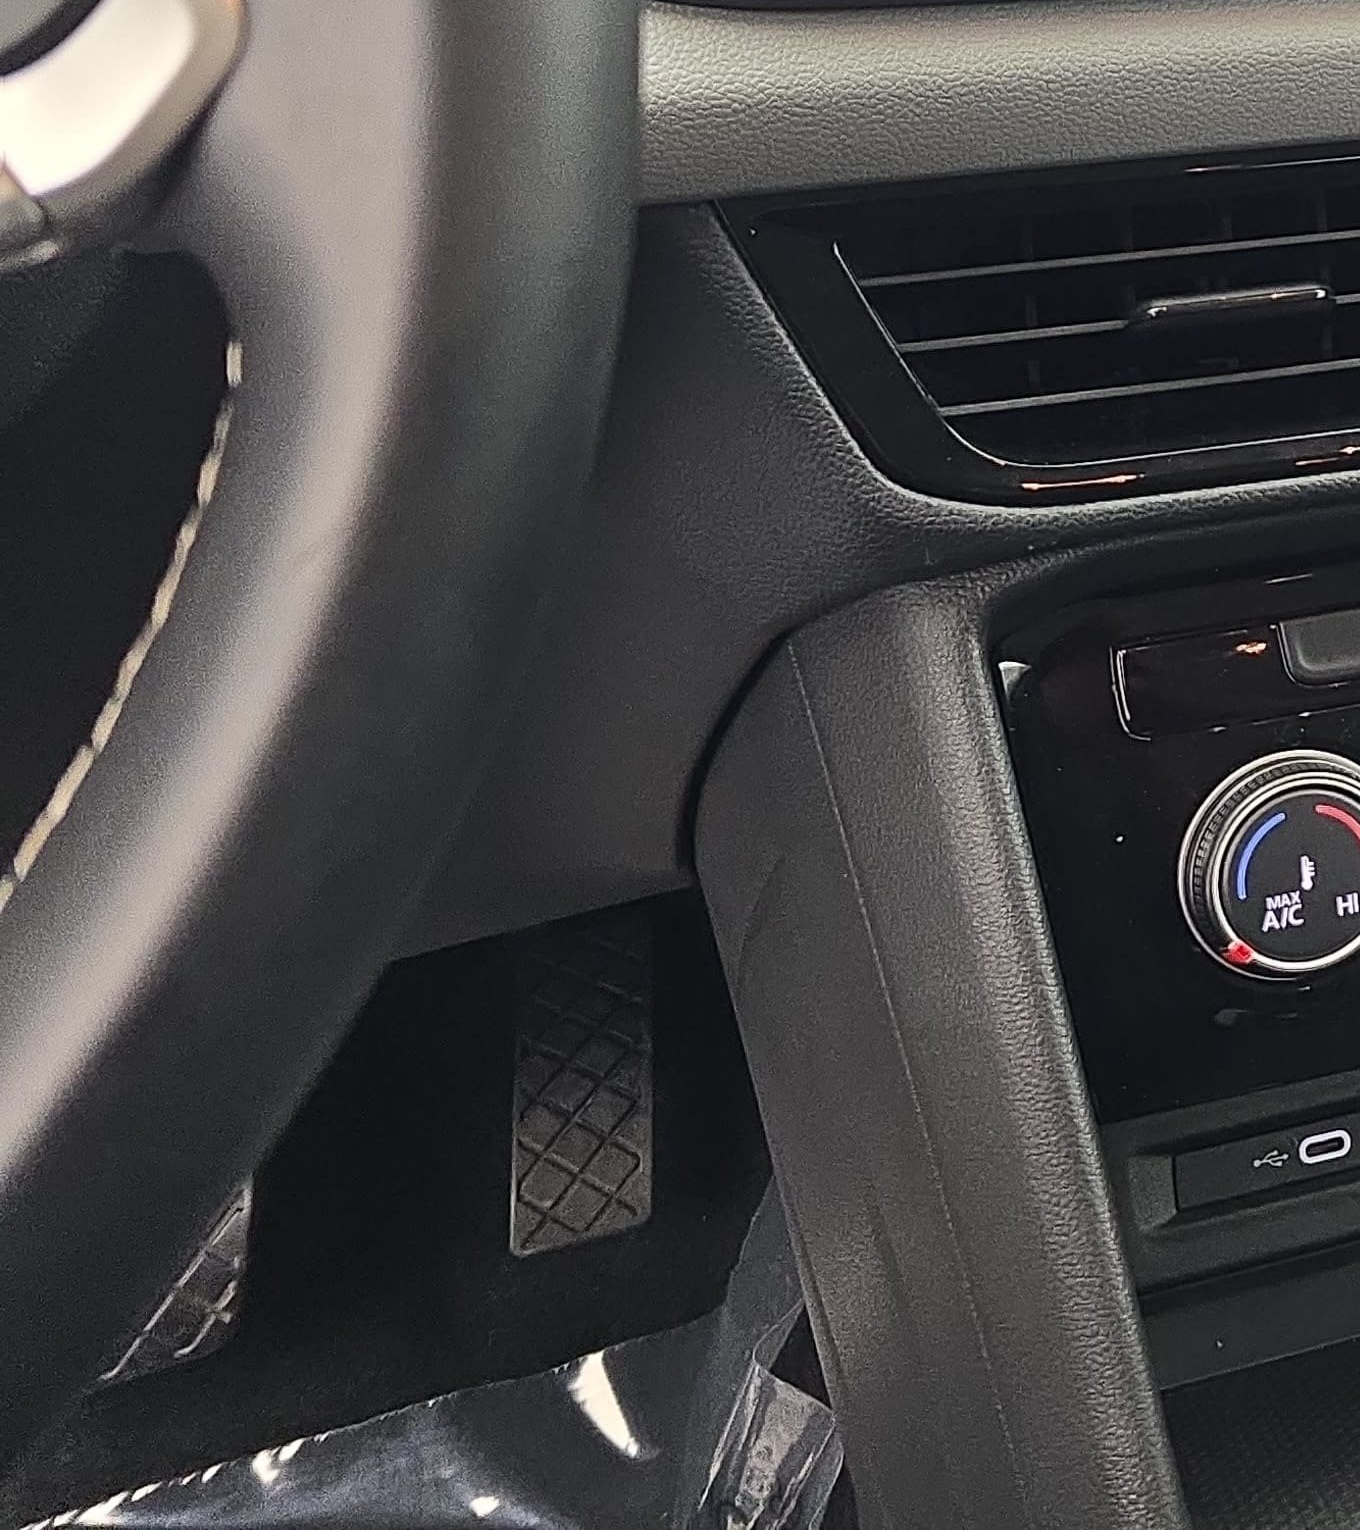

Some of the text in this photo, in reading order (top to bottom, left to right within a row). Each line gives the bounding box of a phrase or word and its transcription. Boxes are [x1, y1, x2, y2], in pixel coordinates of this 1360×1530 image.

[1265, 890, 1301, 910] MAX
[1335, 892, 1360, 917] HI
[1262, 904, 1305, 932] A/C
